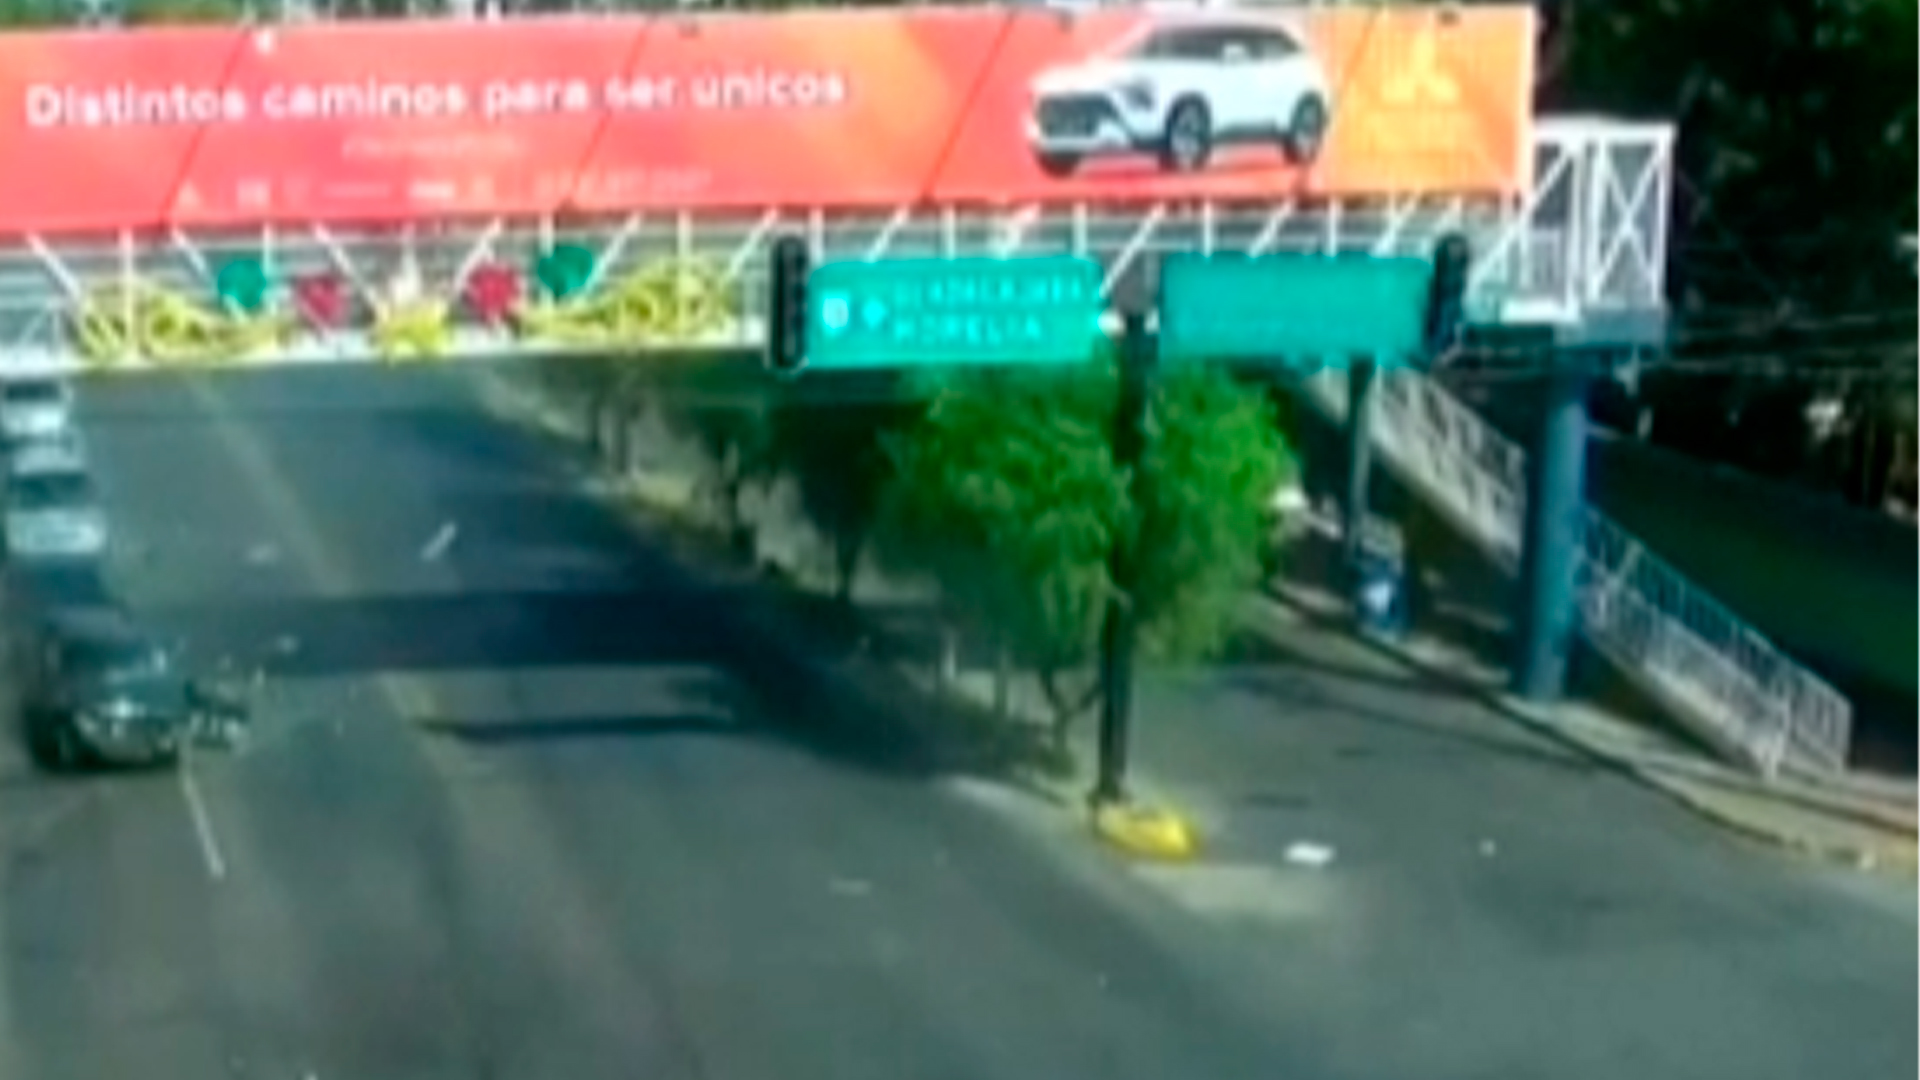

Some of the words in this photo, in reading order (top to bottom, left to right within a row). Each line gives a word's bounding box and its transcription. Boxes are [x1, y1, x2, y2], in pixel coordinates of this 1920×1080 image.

[26, 82, 245, 127] Distintos
[263, 77, 466, 118] caminos
[485, 78, 588, 122] para
[605, 76, 675, 111] ser
